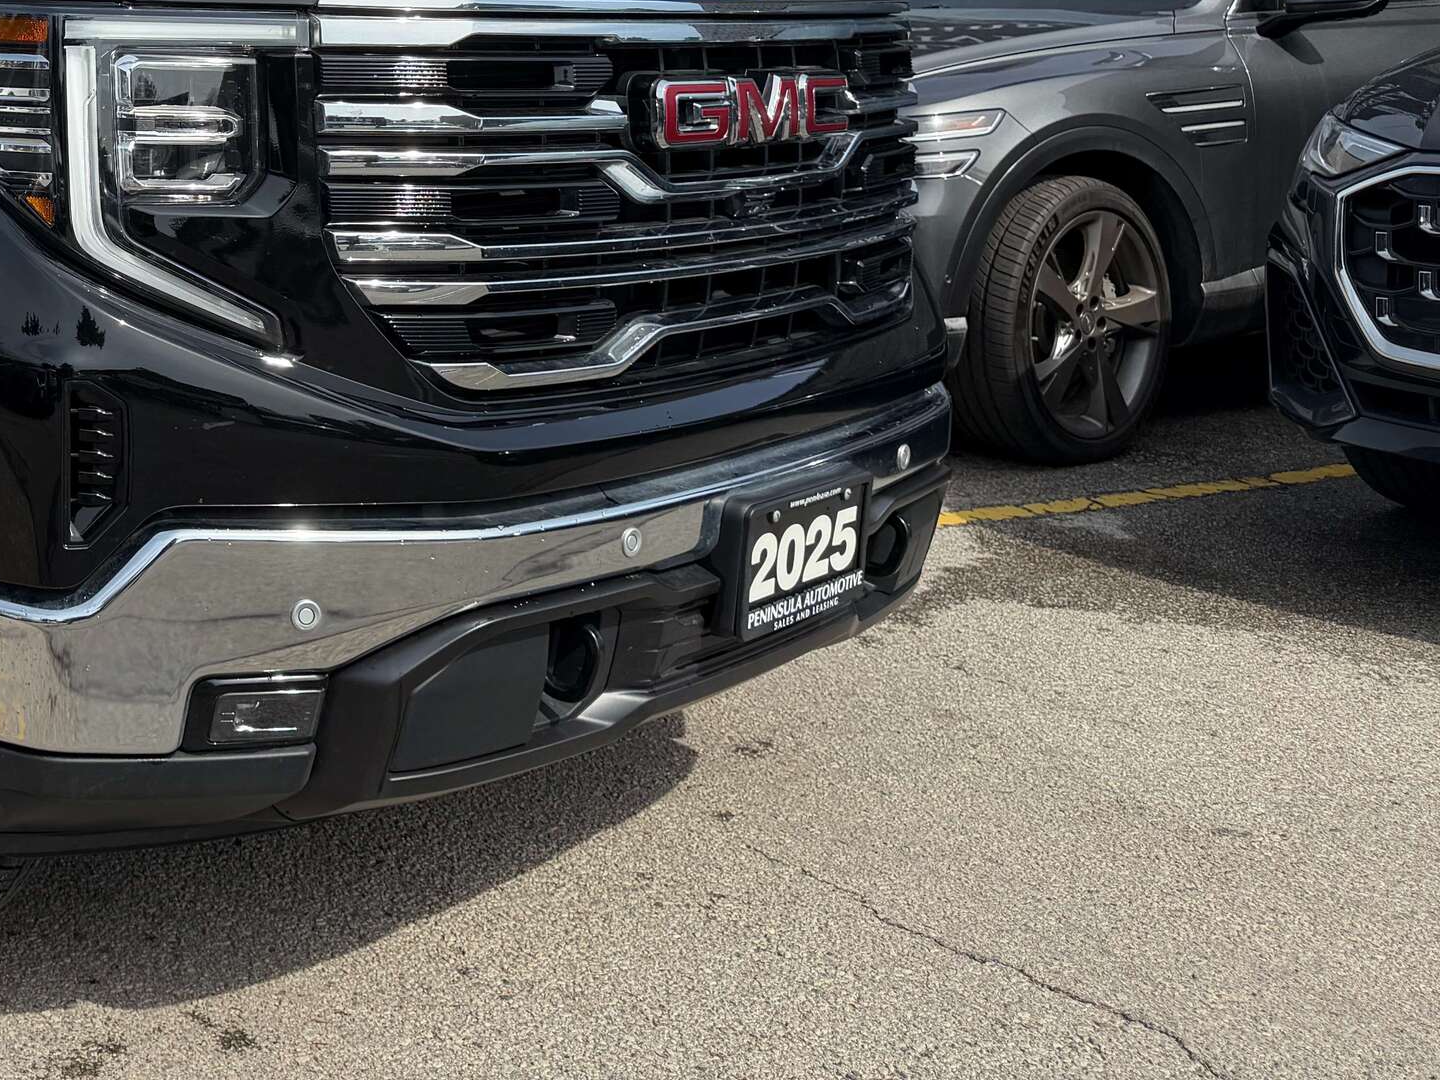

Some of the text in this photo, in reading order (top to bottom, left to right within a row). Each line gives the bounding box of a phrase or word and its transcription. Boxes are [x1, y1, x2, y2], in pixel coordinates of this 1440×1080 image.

[656, 72, 849, 149] GMC
[1020, 212, 1060, 304] MICHELIN
[749, 505, 858, 603] 2025
[747, 569, 864, 630] PENINSULA AUTOMOTIVE
[773, 596, 839, 631] SALES AND LEASING
